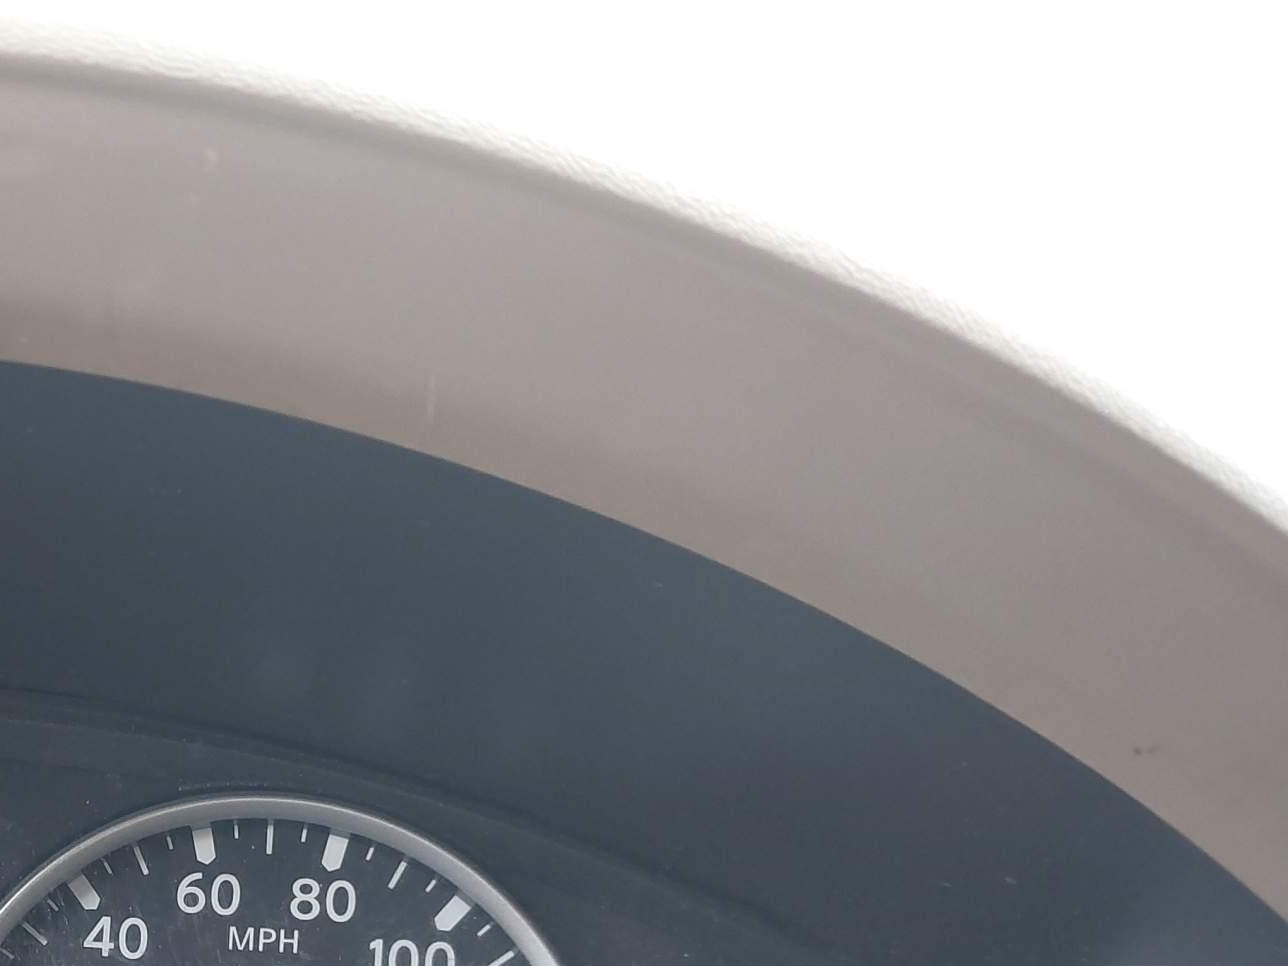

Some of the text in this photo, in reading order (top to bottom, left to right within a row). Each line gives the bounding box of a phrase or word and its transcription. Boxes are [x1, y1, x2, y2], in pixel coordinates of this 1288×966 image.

[176, 872, 241, 916] 60
[290, 878, 356, 923] 80
[83, 916, 148, 960] 40
[228, 925, 299, 954] MPH
